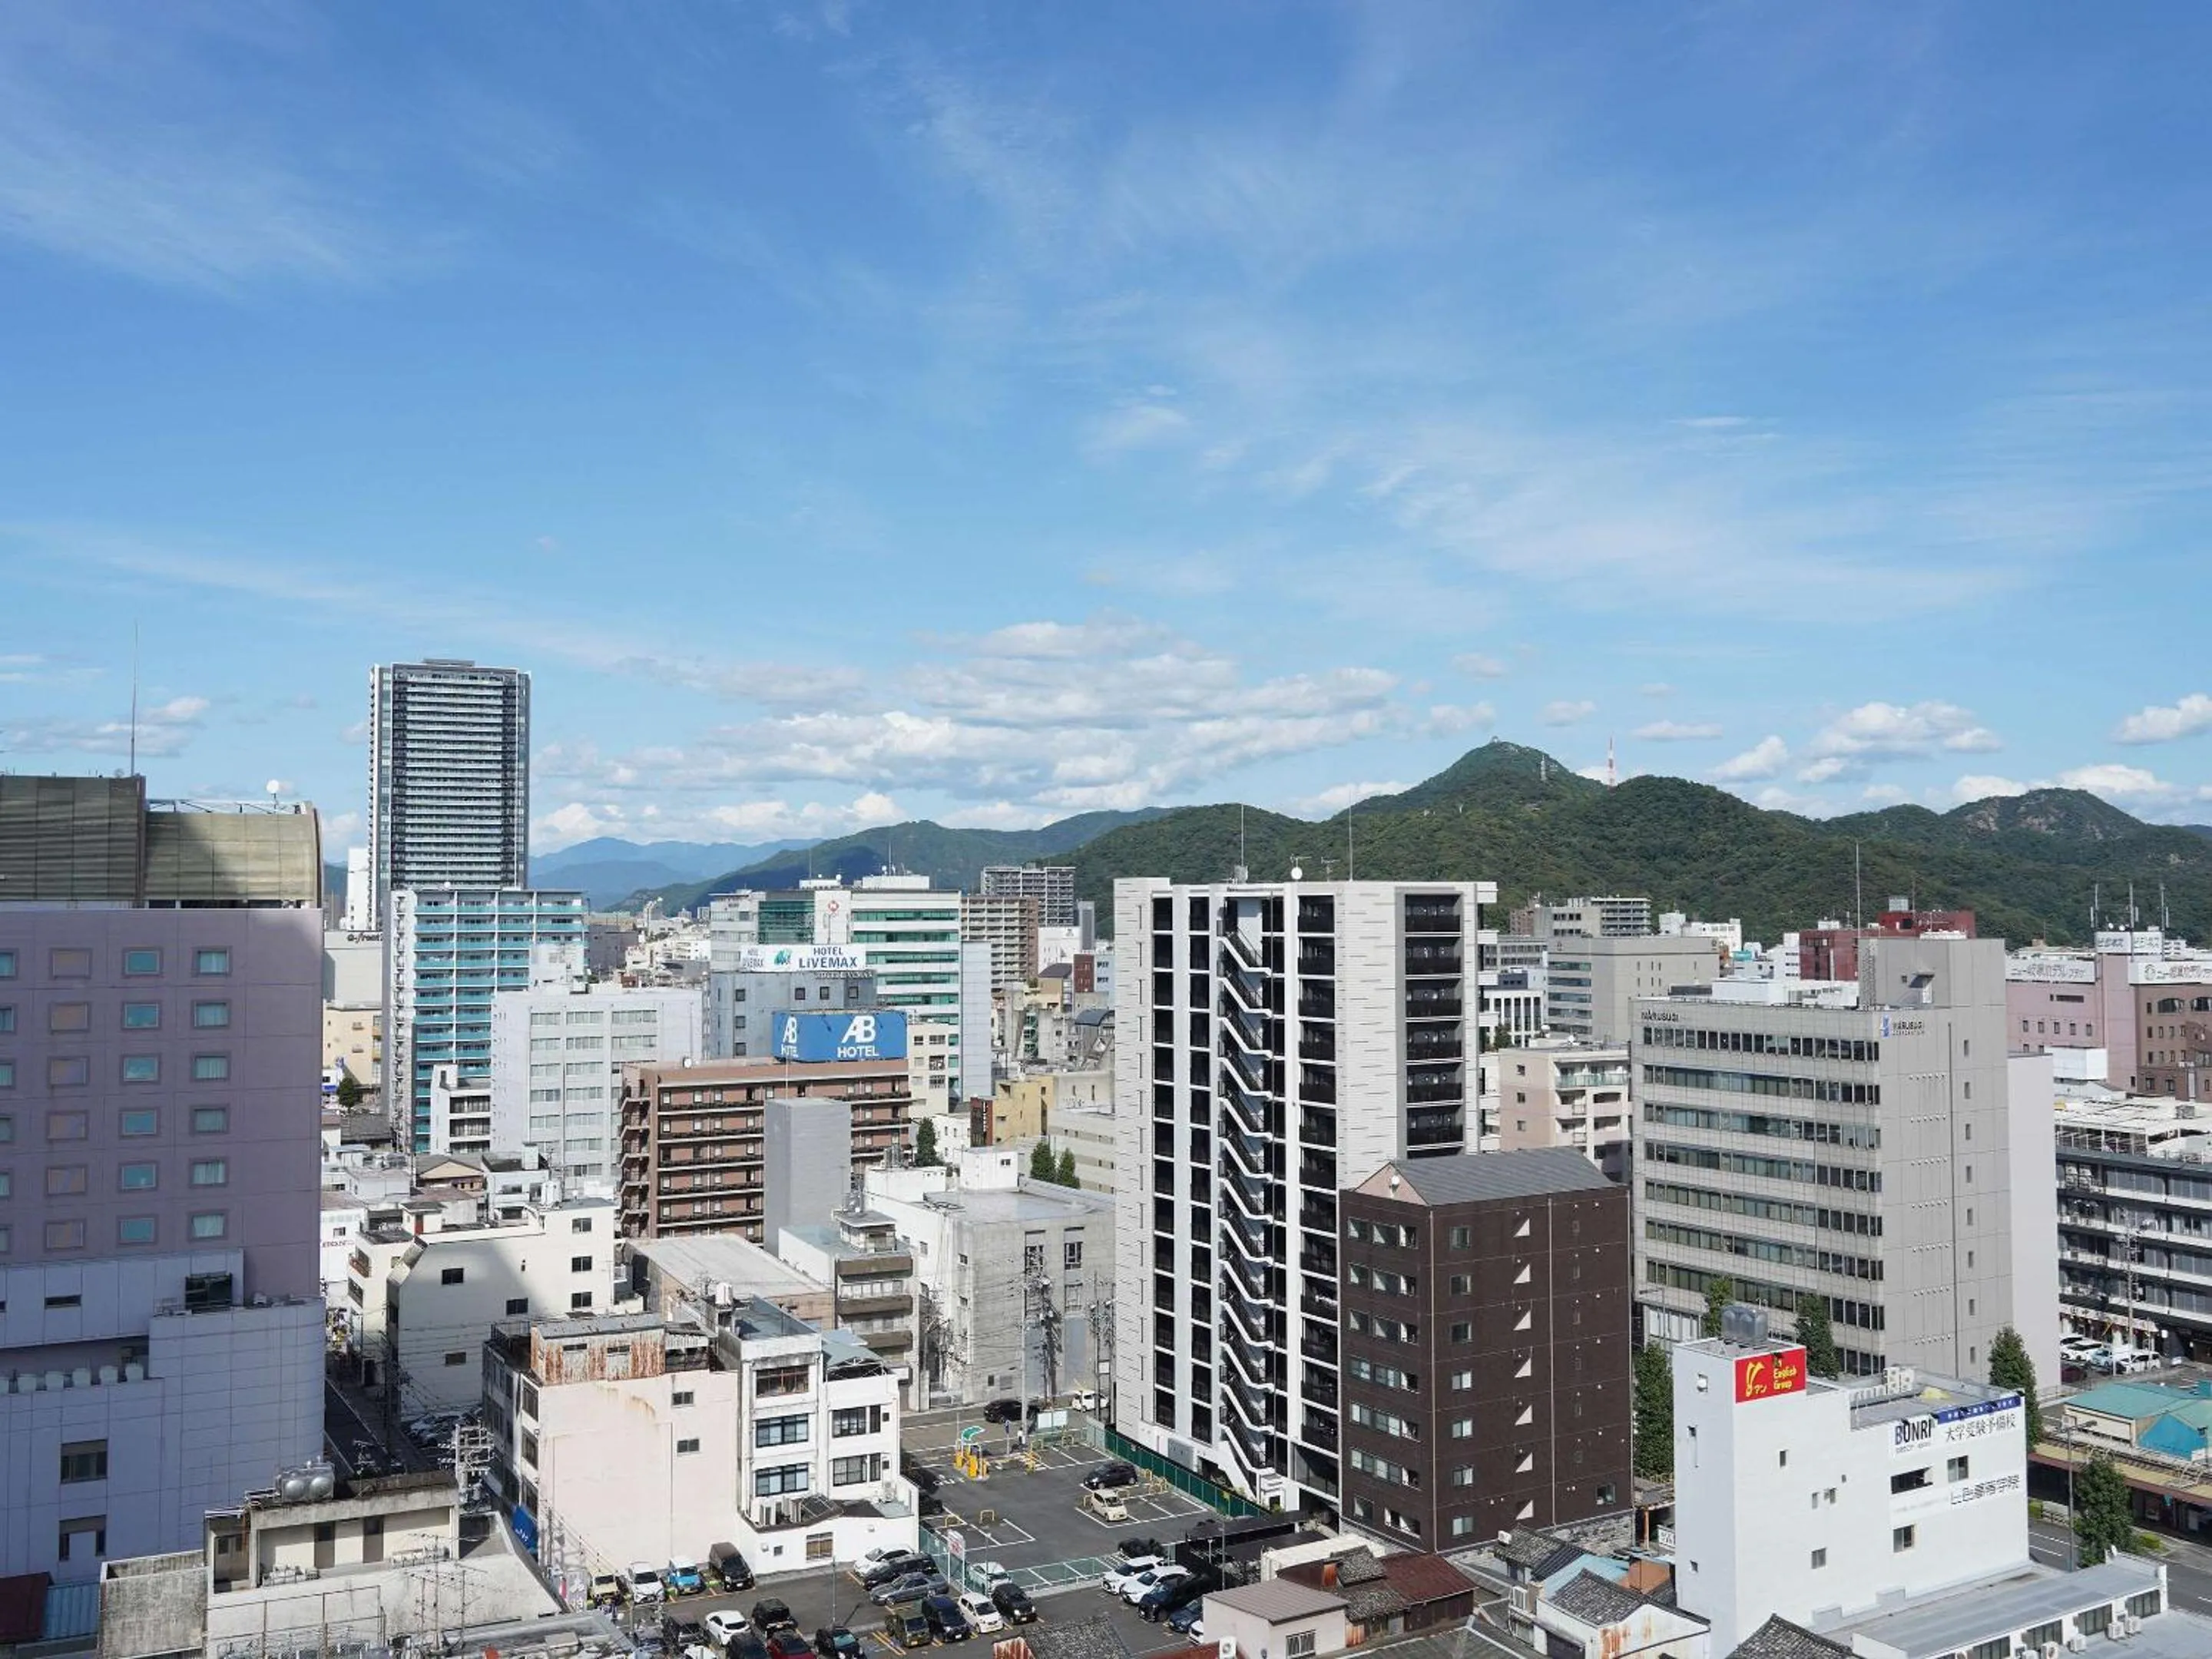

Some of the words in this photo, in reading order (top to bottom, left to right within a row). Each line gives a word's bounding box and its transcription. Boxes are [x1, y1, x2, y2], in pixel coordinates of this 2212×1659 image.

[813, 946, 843, 955] HOTEL
[783, 1015, 797, 1044] AB
[841, 1015, 876, 1044] AB
[837, 1045, 879, 1058] HOTEL
[1894, 1419, 1932, 1445] BONRI
